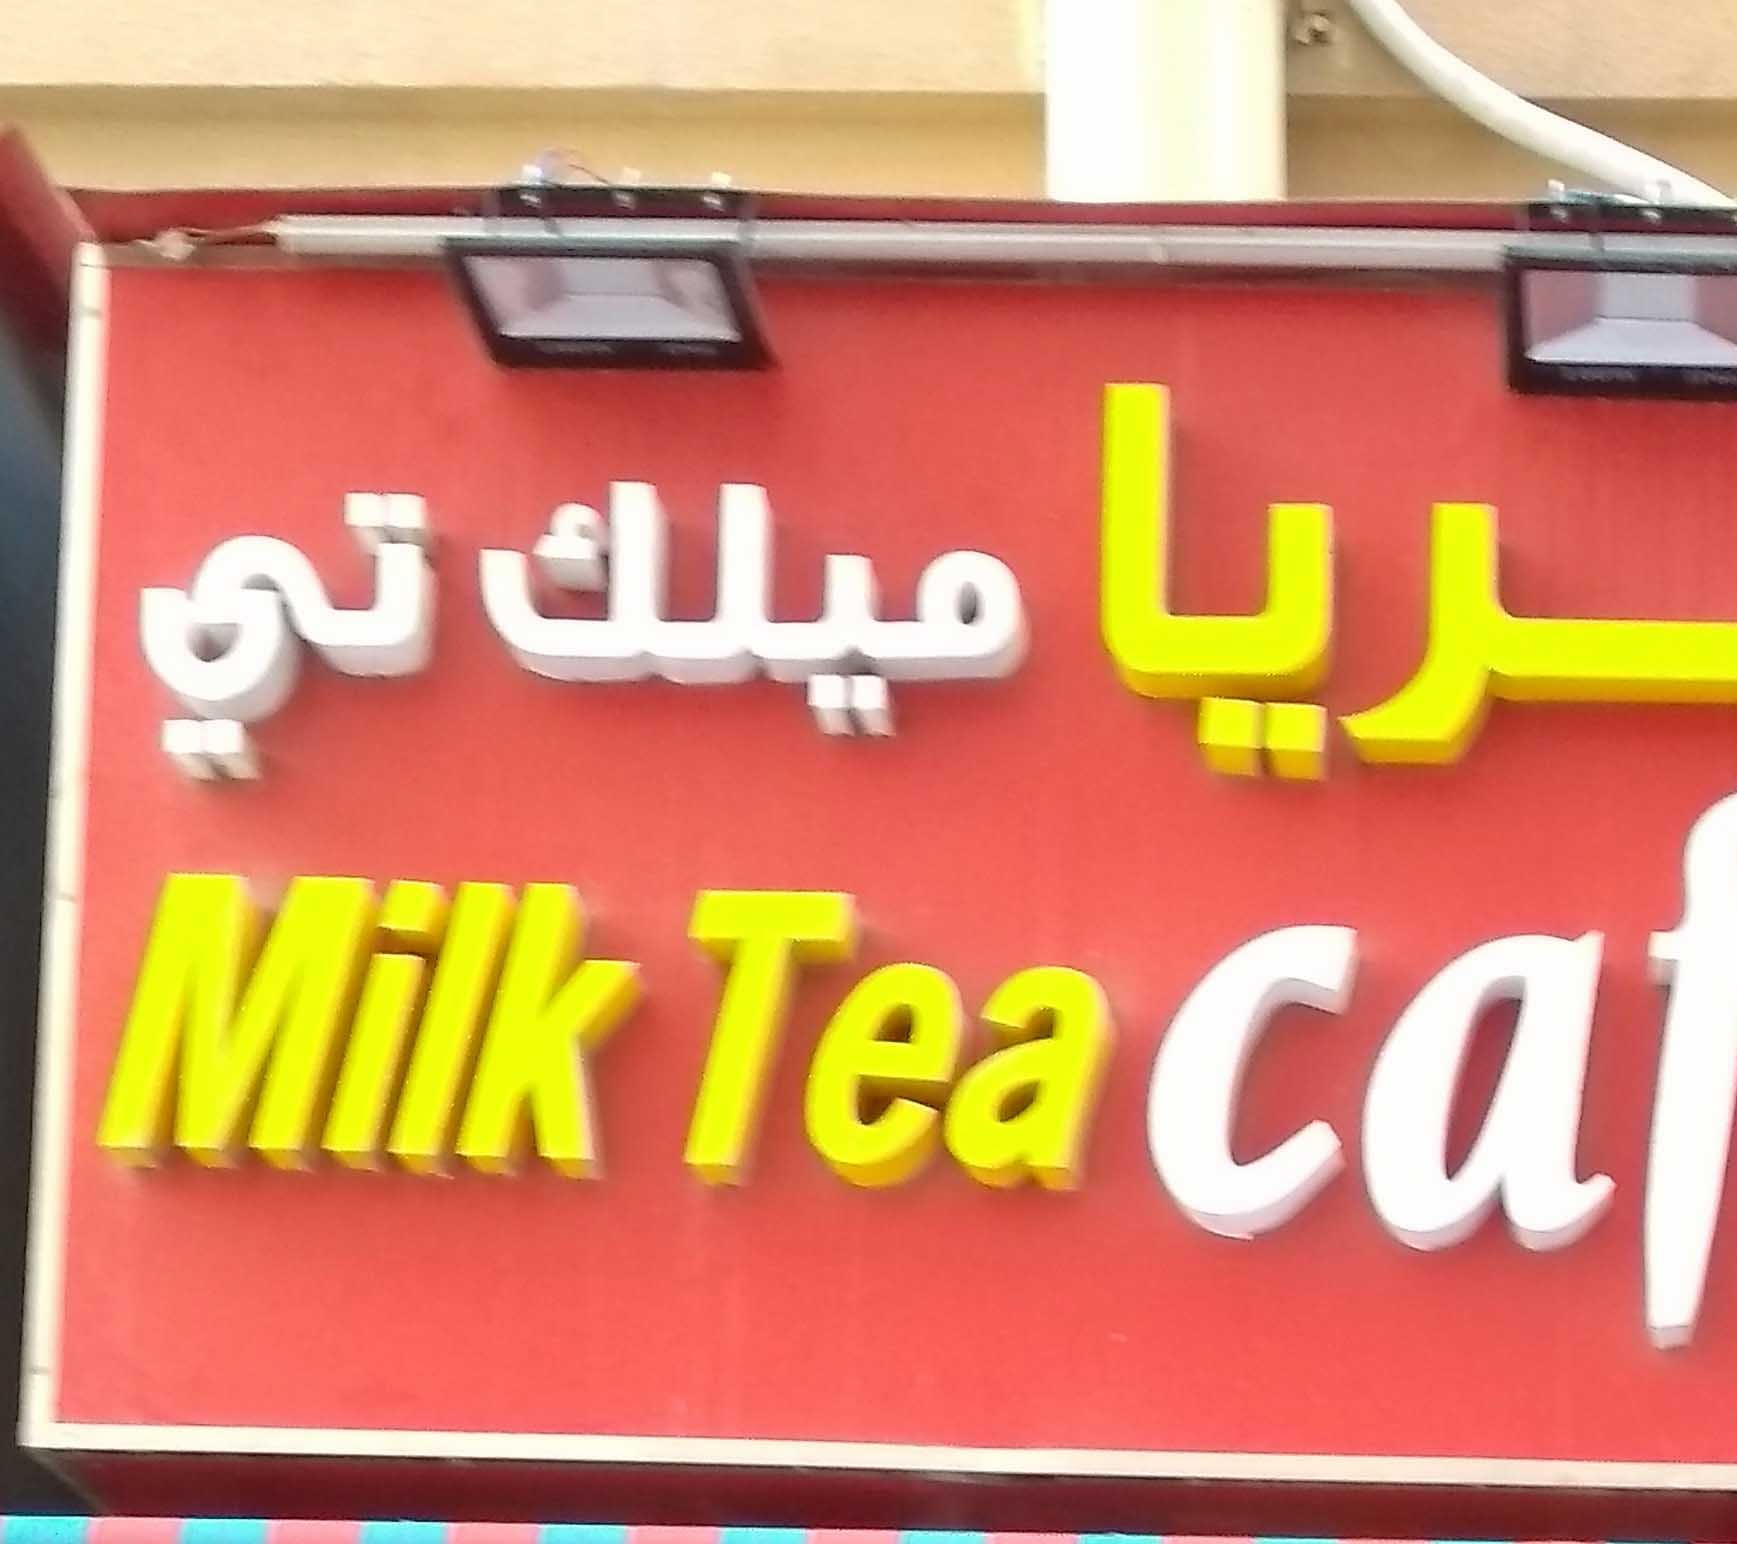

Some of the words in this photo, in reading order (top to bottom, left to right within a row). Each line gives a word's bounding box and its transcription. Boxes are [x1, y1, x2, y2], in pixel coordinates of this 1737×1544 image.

[138, 490, 436, 782] تي
[478, 480, 1030, 738] ميلك
[97, 872, 642, 1180] Milk
[683, 888, 1114, 1192] Tea
